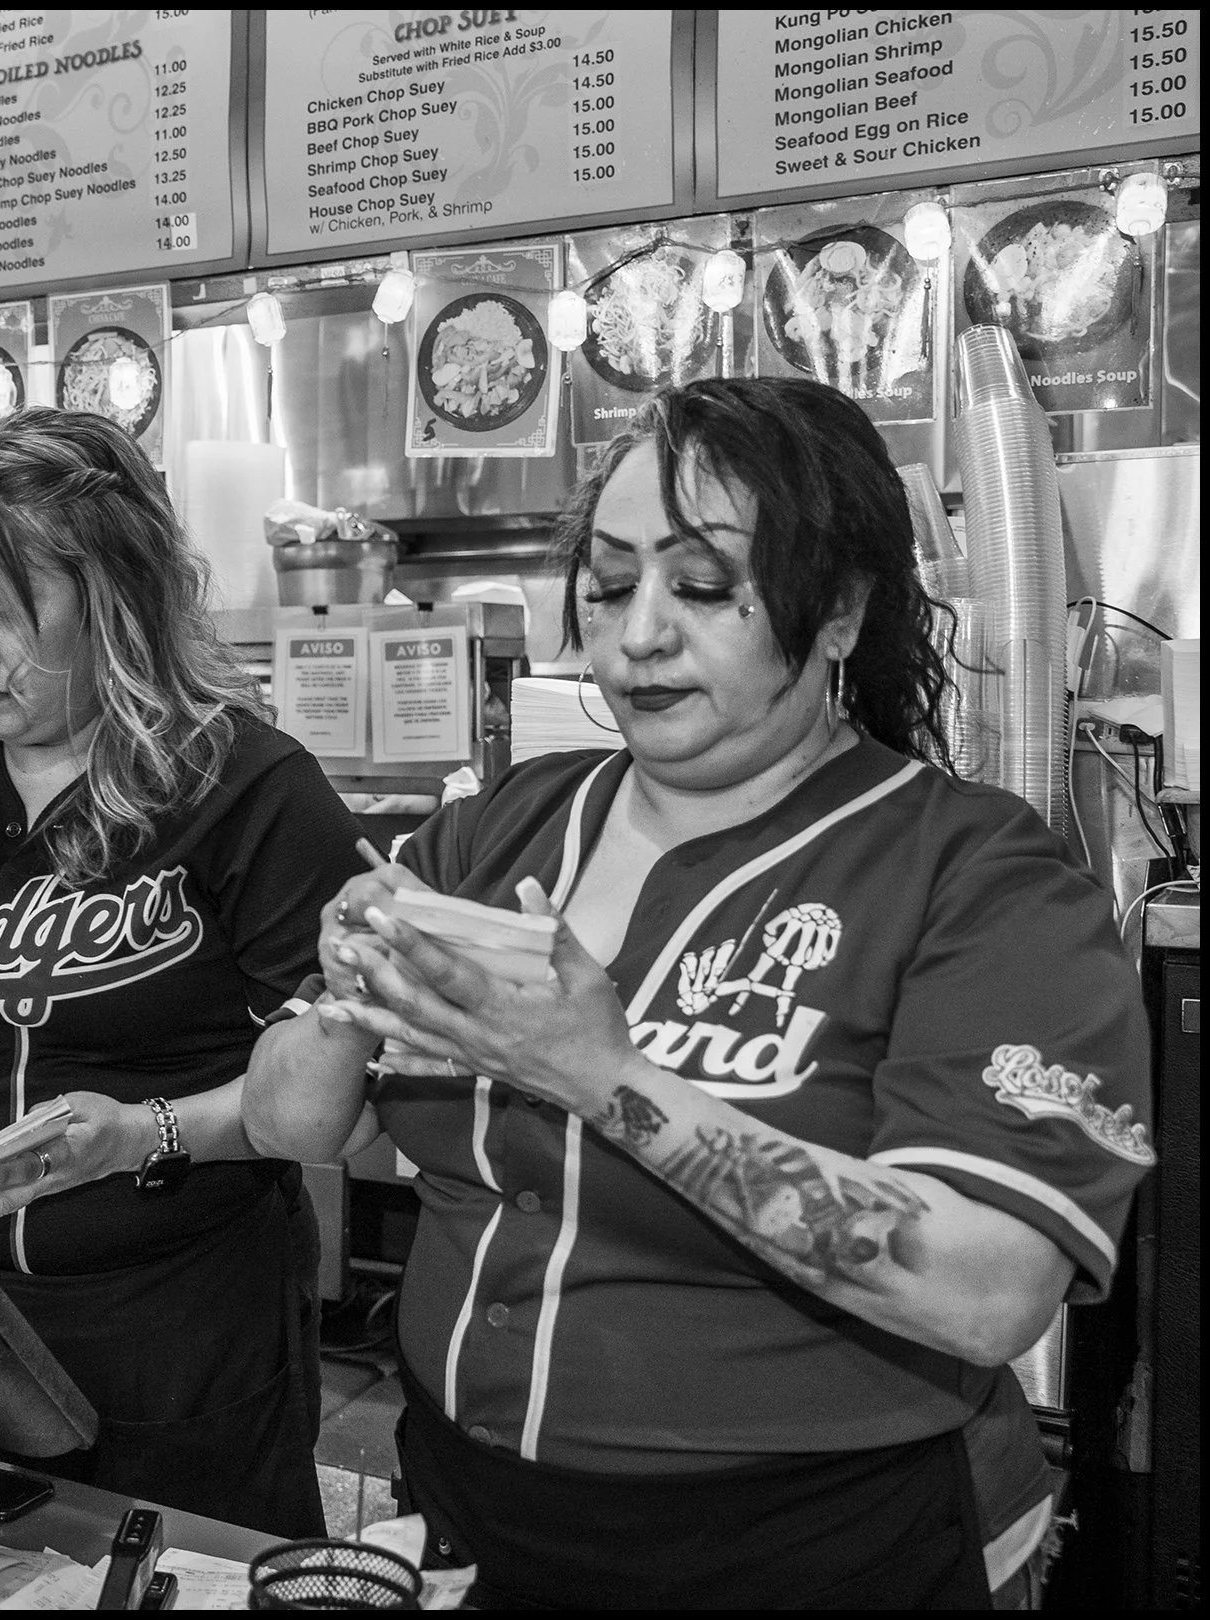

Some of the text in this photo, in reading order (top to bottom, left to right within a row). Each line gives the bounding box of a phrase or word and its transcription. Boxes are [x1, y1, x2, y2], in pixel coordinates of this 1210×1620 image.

[19, 16, 43, 29] Rice
[394, 15, 452, 43] CHOP
[775, 13, 952, 54] Mongolian Chicken
[776, 12, 820, 30] Kung
[29, 35, 54, 47] Rice
[54, 40, 143, 75] NOODLES
[373, 26, 545, 66] Served with White Rice Soup
[155, 60, 187, 75] 11.00
[359, 37, 561, 83] Substitute with Fried Rice Add $3.00
[775, 40, 942, 78] Mongolian Shrimp
[775, 20, 1187, 103] Mongolian Seafood 15.50
[155, 82, 186, 97] 12.25
[308, 49, 614, 113] Chicken Chop Suey 14.50
[775, 48, 1187, 127] Mongolian Beef 15.50
[155, 104, 186, 119] 12.25
[307, 73, 614, 134] BBQ Pork Chop Suey 14.50
[775, 75, 1186, 150] Seafood Egg on Rice 15.00
[307, 96, 614, 155] Beef Chop Suey 15.00
[775, 102, 1186, 175] Sweet Sour Chicken 15.00
[9, 150, 56, 166] Noodles
[155, 126, 186, 141] 11.00
[307, 119, 614, 176] Shrimp Chop Suey 15.00
[27, 172, 56, 184] Suey
[59, 162, 108, 178] Noodles
[155, 148, 186, 162] 12.50
[308, 142, 615, 197] Seafood Chop Suey 15.00
[21, 193, 51, 206] Chop
[55, 188, 83, 200] Suey
[87, 179, 136, 195] Noodles
[155, 170, 186, 184] 13.25
[155, 192, 187, 206] 14.00
[310, 165, 615, 218] House Chop Suey 15.00
[156, 214, 189, 229] 14.00
[328, 201, 492, 232] Chicken, Pork, Shrimp
[157, 235, 190, 250] 14.00
[876, 386, 912, 399] Soup
[1028, 370, 1137, 389] Noodles Soup
[594, 407, 637, 421] Shrimp
[301, 642, 344, 654] AVISO
[395, 641, 443, 658] AVISO
